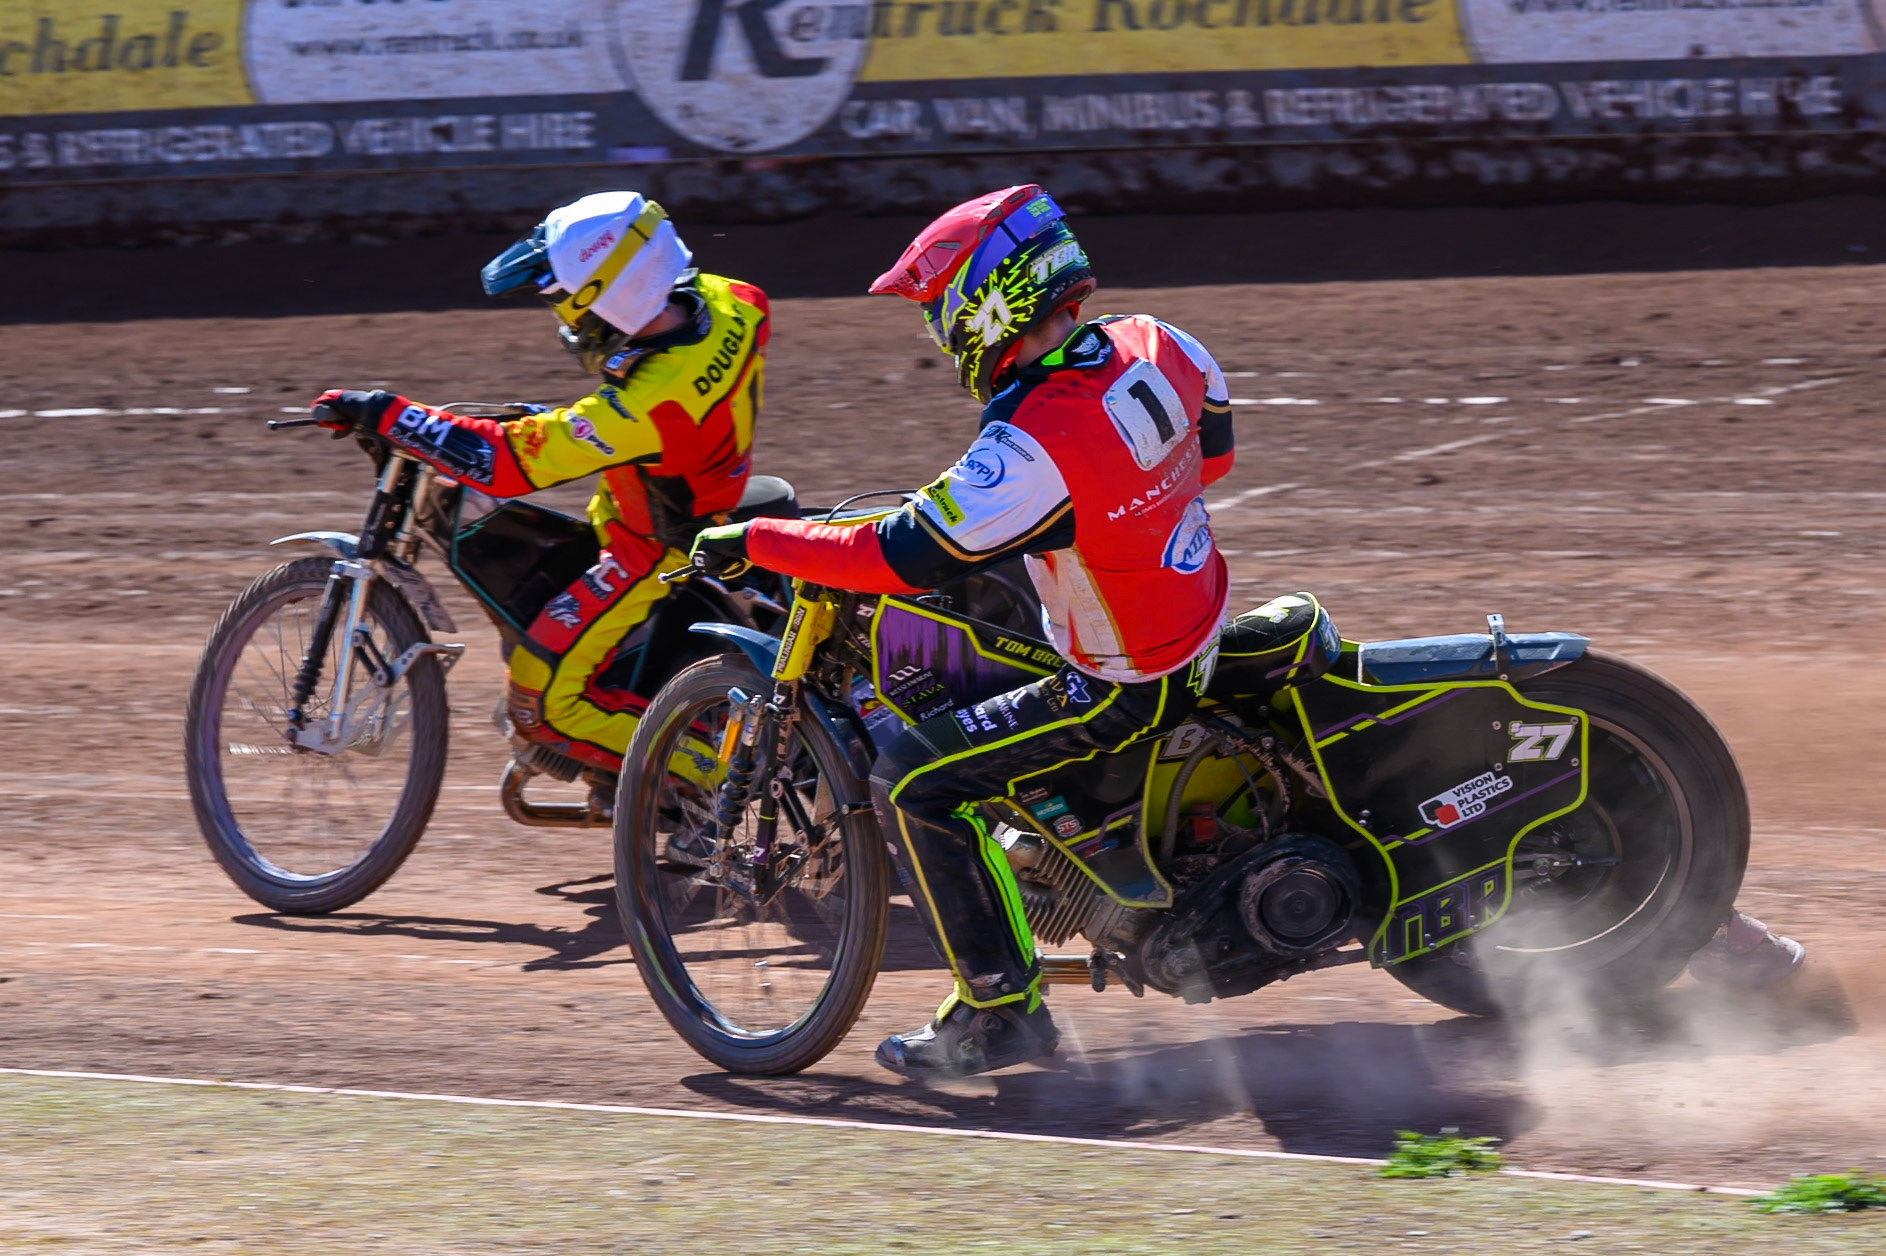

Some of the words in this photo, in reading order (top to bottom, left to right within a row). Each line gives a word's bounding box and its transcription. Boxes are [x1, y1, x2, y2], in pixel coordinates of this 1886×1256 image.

[1127, 379, 1177, 445] 1
[995, 636, 1033, 657] TOM
[1507, 721, 1575, 763] 27
[1452, 773, 1493, 798] VISION
[1457, 778, 1511, 808] PLASTICS
[1461, 802, 1483, 818] LTD
